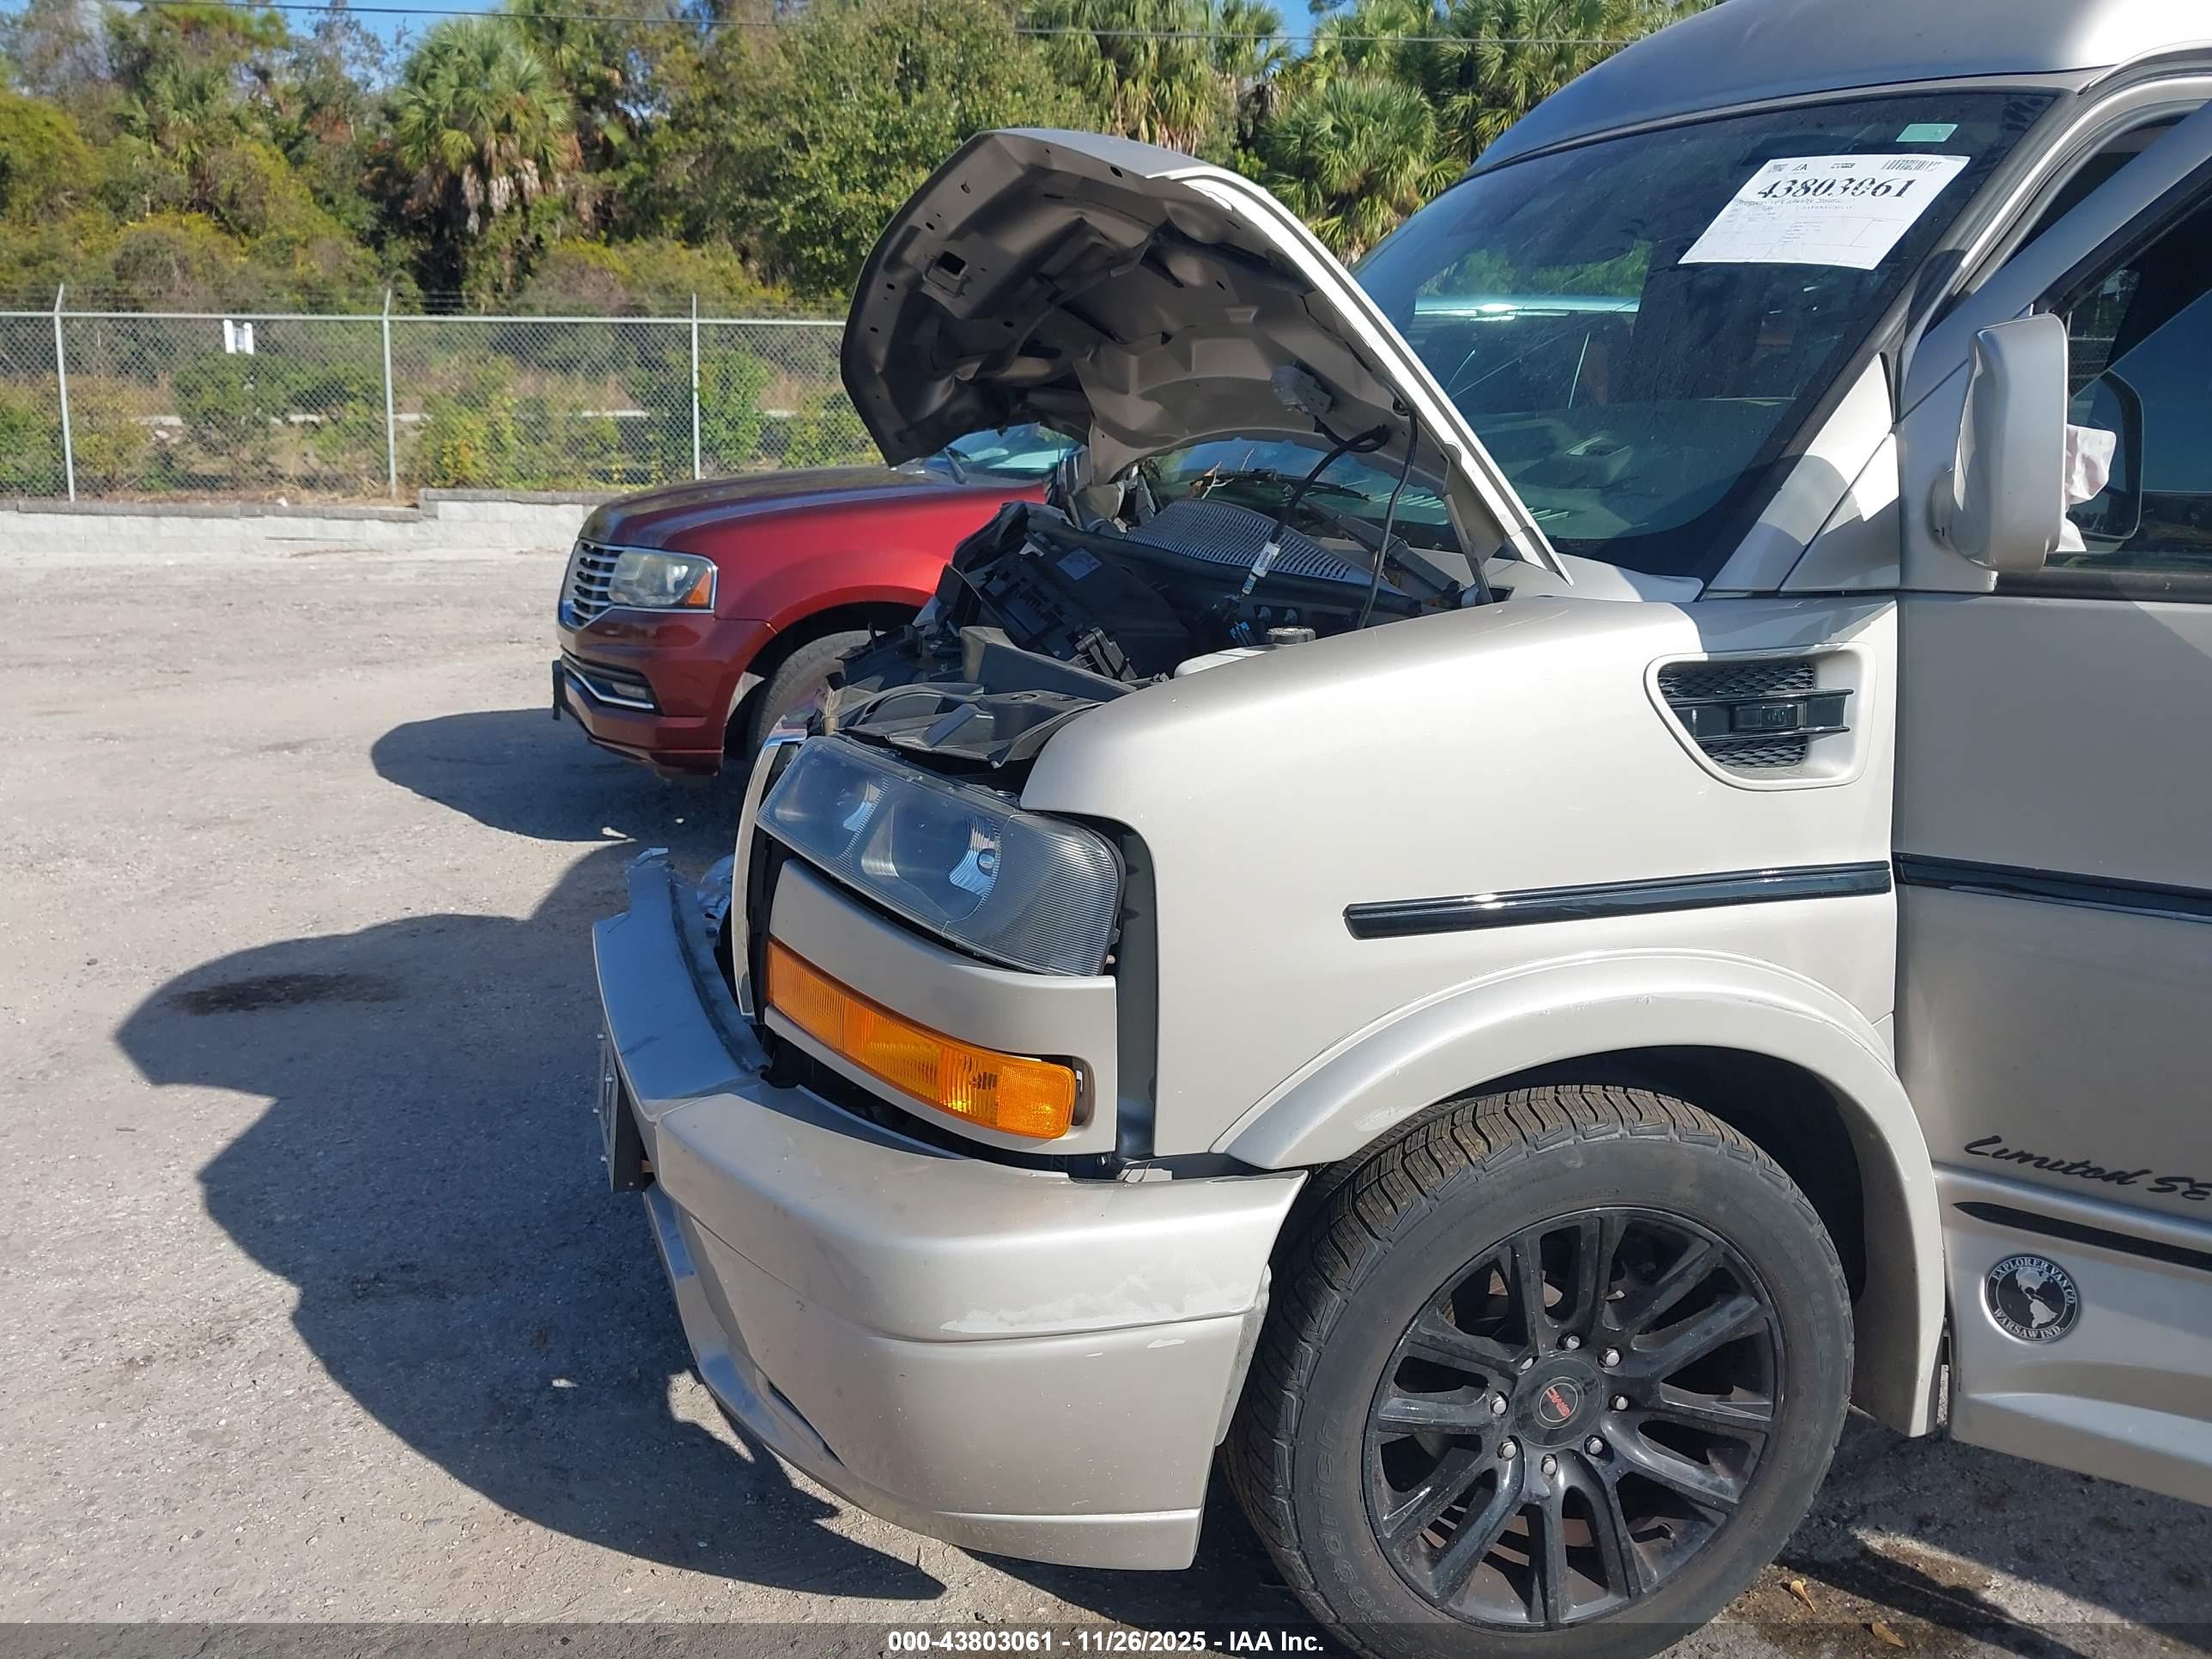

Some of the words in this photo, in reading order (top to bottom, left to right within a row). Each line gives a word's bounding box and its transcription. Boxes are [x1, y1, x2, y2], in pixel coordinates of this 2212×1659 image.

[1758, 177, 1917, 198] 43803061
[1964, 1134, 2153, 1185] Limited
[1991, 1258, 2049, 1280] EXPLORER
[2050, 1266, 2071, 1291] VAN
[1993, 1308, 2039, 1339] WARSAW
[2039, 1326, 2064, 1339] IND.
[1545, 1386, 1571, 1418] GMC
